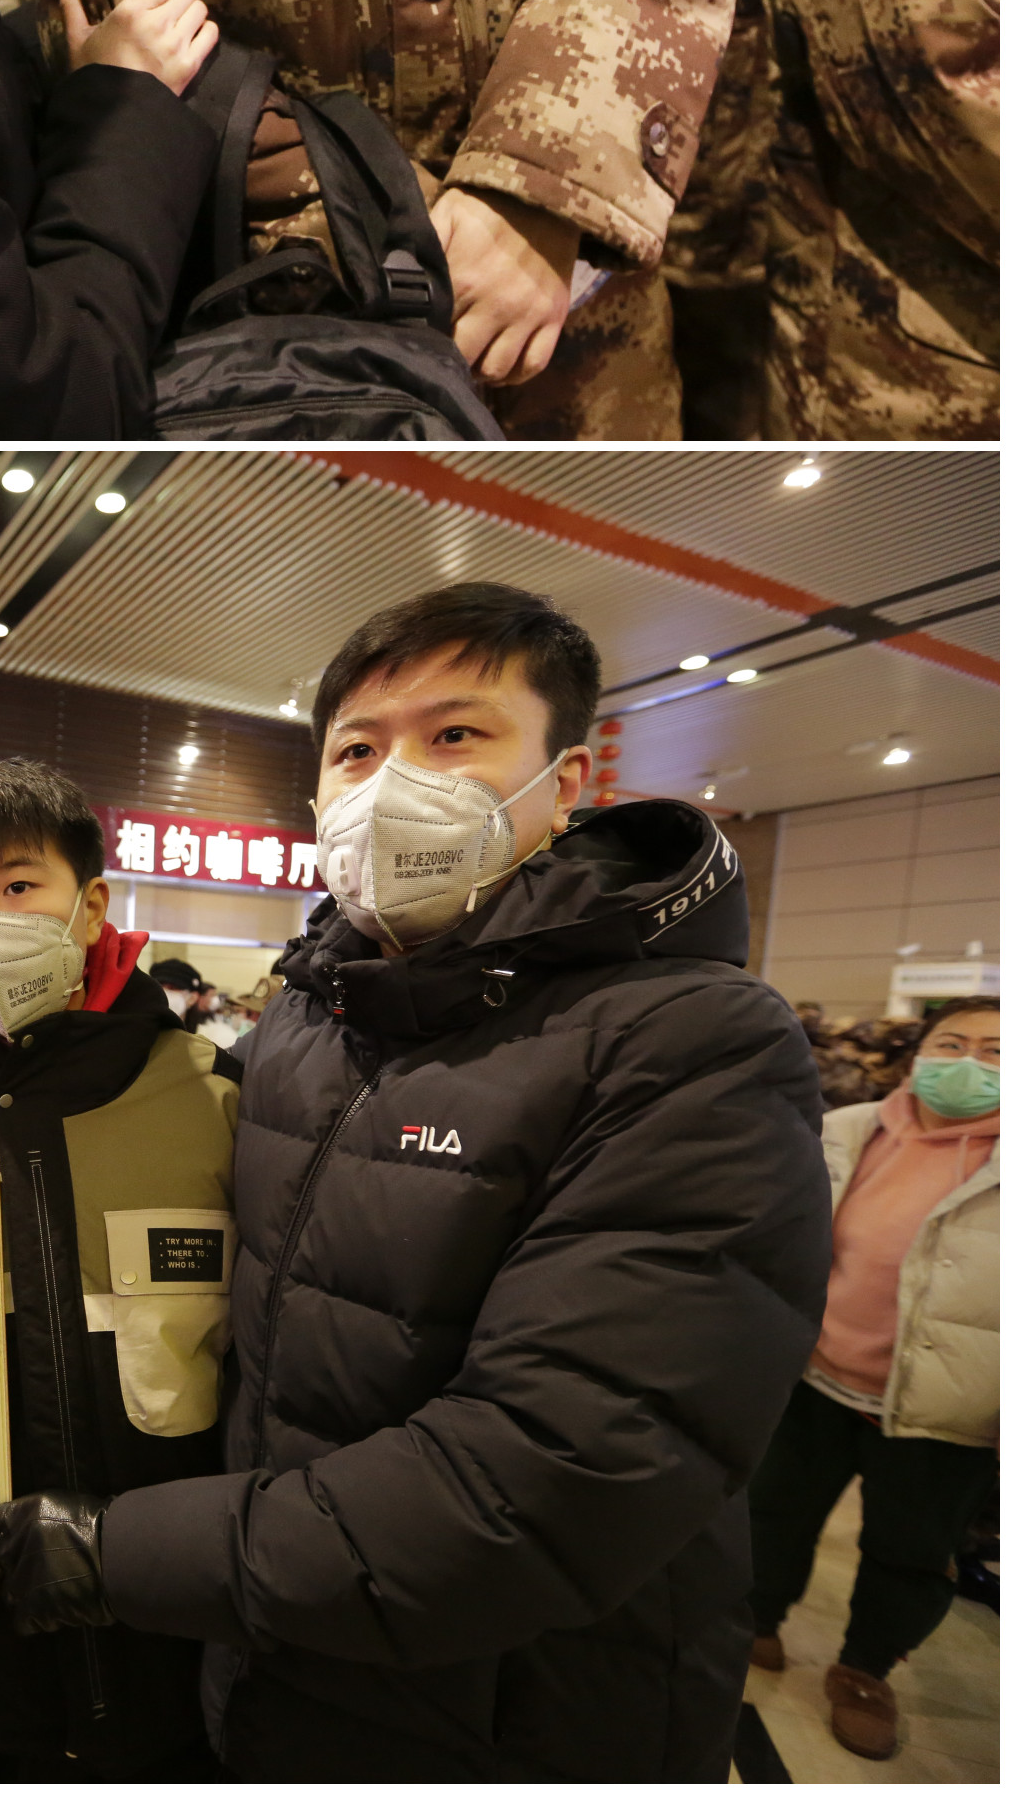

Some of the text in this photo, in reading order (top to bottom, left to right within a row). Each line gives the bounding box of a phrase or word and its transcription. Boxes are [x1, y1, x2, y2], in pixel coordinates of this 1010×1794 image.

[116, 819, 318, 888] 相约咖啡厅
[413, 849, 464, 867] JE2008VC
[653, 871, 715, 925] 1911
[400, 1125, 462, 1155] FILA
[168, 1261, 187, 1269] WHO
